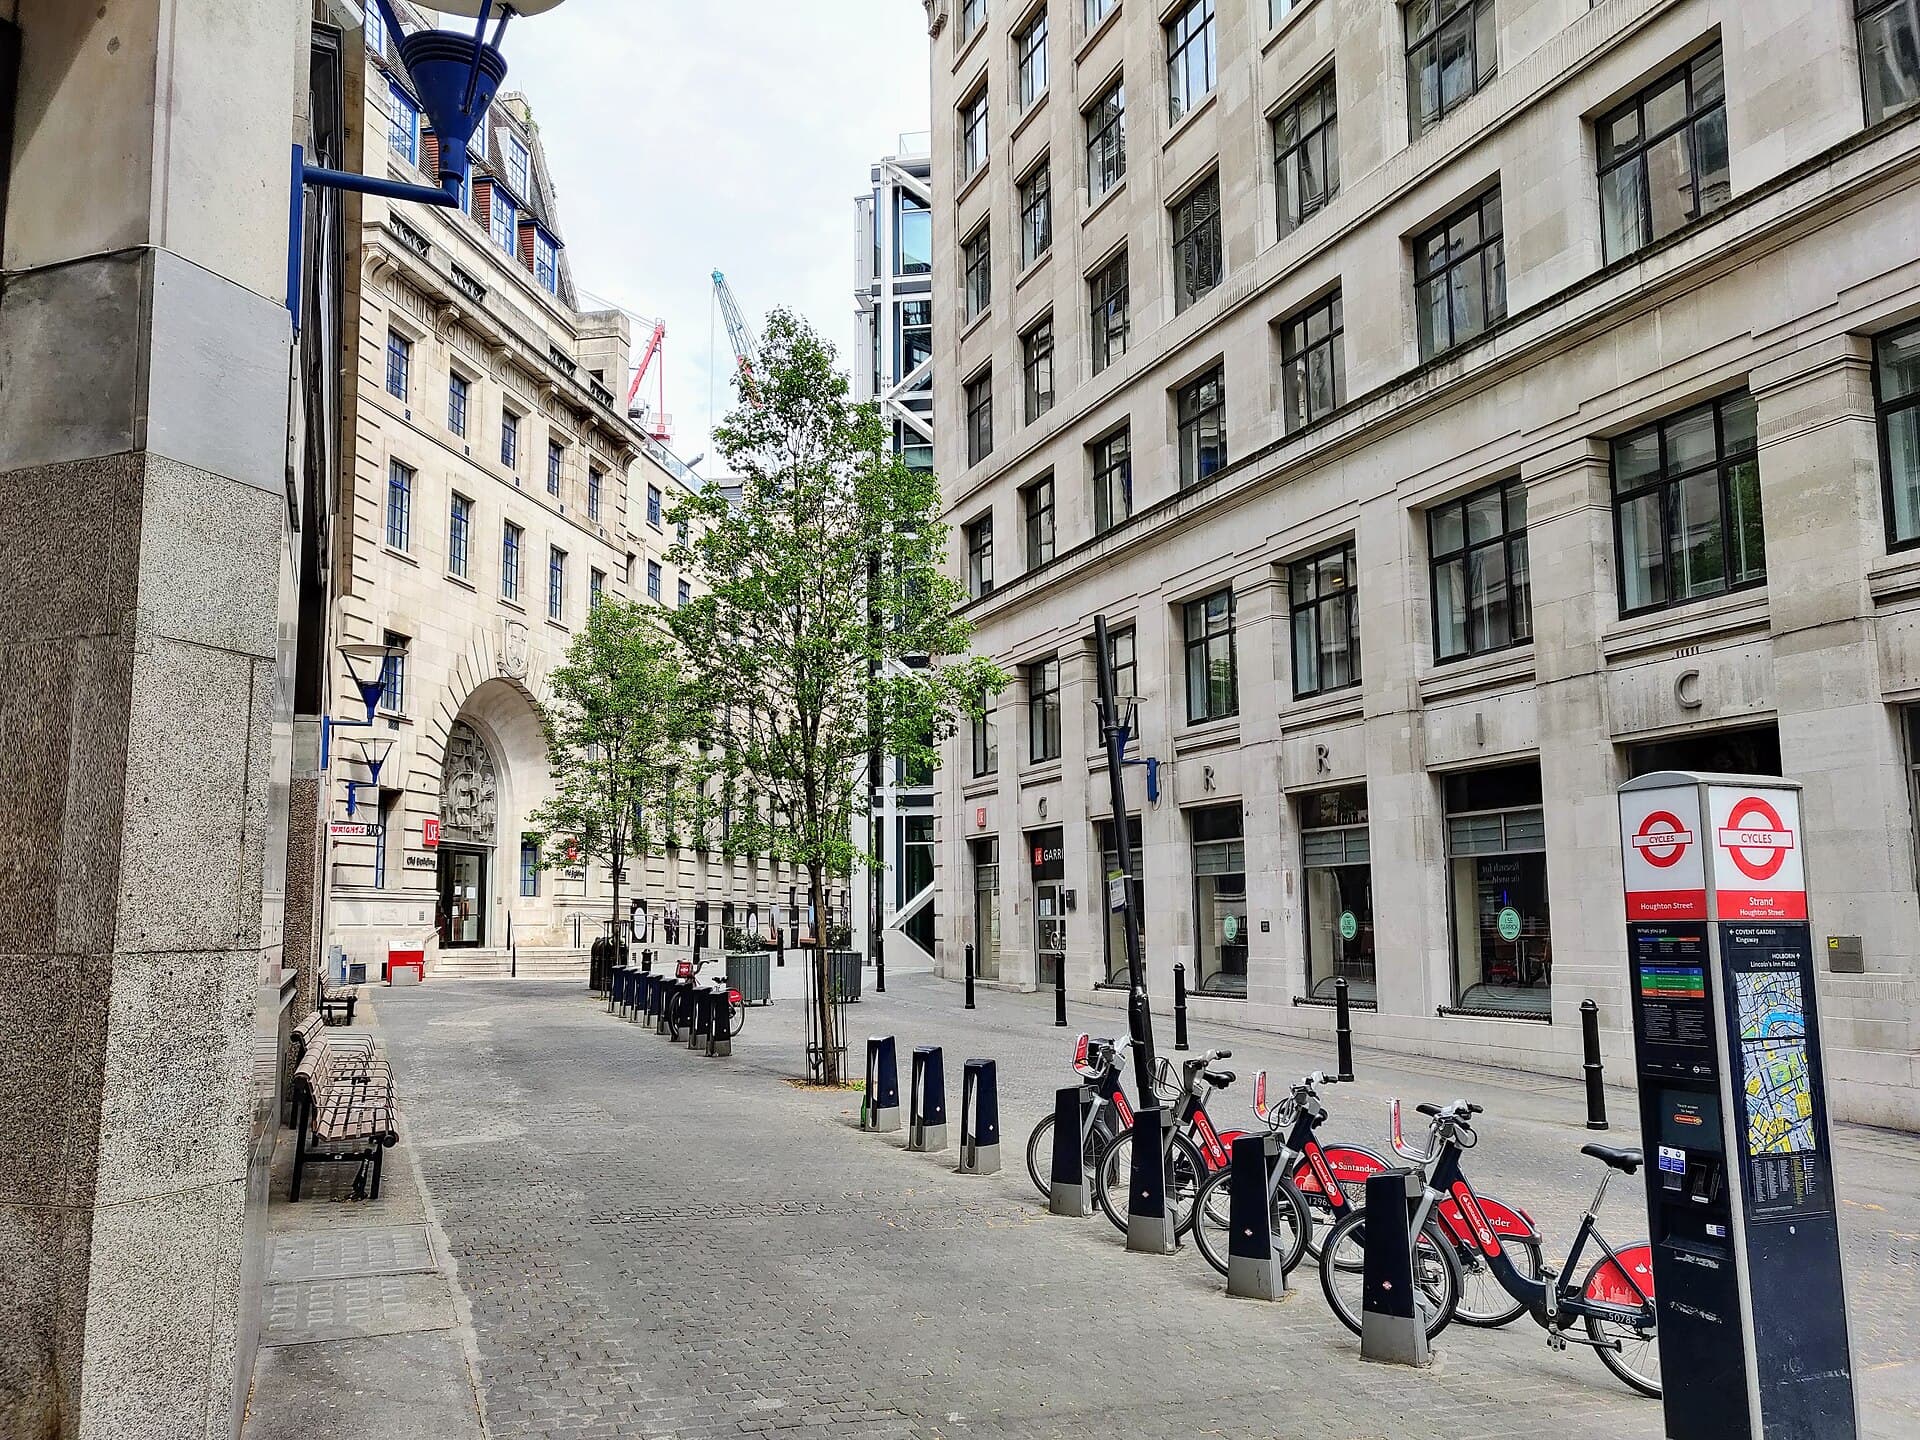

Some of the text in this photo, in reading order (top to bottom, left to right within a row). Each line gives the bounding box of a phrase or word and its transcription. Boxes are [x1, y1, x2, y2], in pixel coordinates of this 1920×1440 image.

[1203, 765, 1216, 792] R
[1315, 743, 1331, 774] R
[1674, 669, 1702, 708] C
[427, 823, 438, 841] LSE
[1649, 835, 1675, 844] CYCLES
[1741, 833, 1773, 844] CYCLES
[1640, 902, 1693, 911] Houghton Street
[1749, 896, 1773, 906] Strand
[1739, 909, 1767, 917] Houghton
[1338, 1162, 1378, 1173] Santander
[1466, 1201, 1482, 1228] Santander
[1608, 1312, 1637, 1325] 50785
